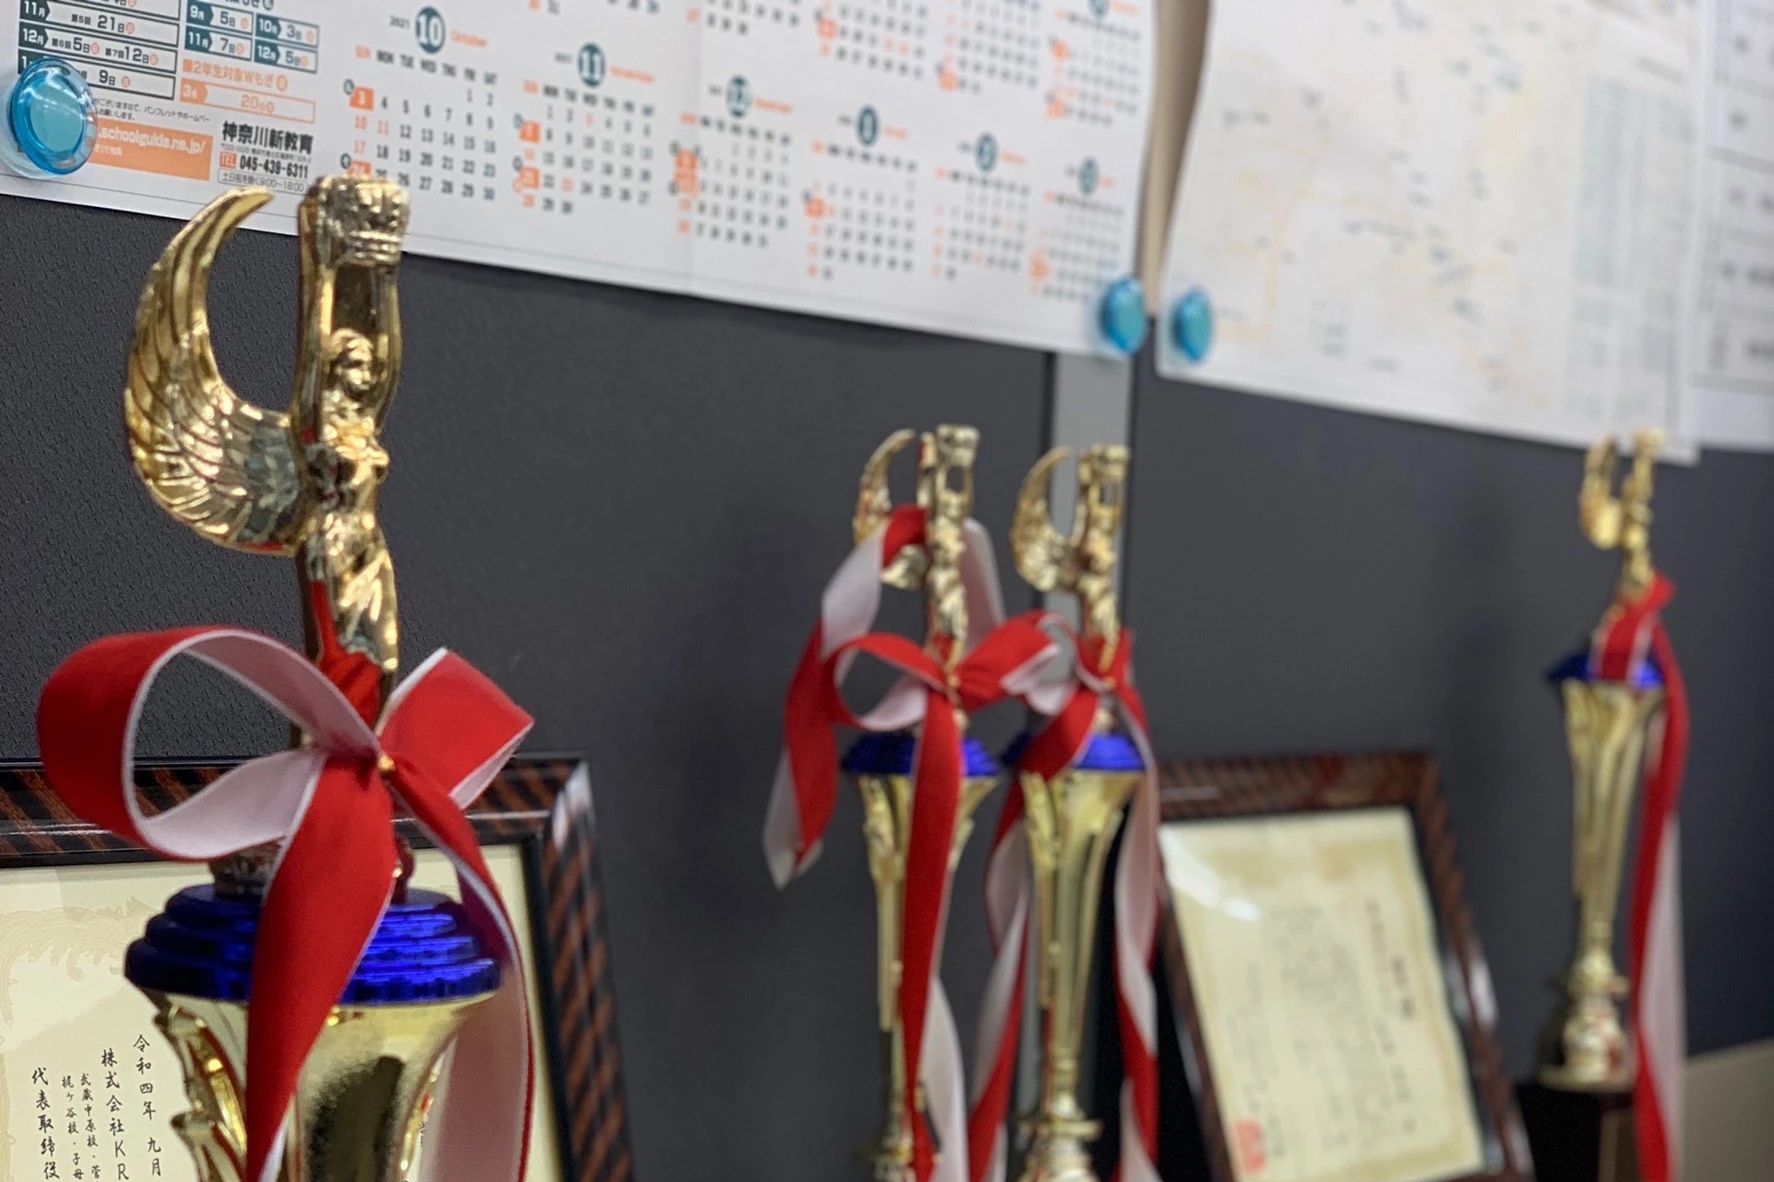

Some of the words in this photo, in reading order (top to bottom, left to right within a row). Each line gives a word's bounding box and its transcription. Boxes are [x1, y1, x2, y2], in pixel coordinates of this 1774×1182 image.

[24, 1, 46, 18] 11月
[97, 15, 125, 33] 21日
[190, 5, 205, 20] 9月
[220, 11, 236, 27] 5日
[259, 18, 278, 35] 10月
[188, 31, 209, 48] 11月
[219, 37, 235, 53] 7日
[417, 13, 443, 48] 10
[22, 28, 45, 46] 12月
[73, 37, 90, 54] 5日
[124, 46, 149, 64] 12日
[376, 49, 394, 63] MON
[401, 54, 414, 69] TUE
[421, 59, 437, 73] WED
[99, 70, 116, 85] 9日
[222, 120, 314, 155] 神奈川新教育
[239, 155, 309, 179] 045-439-6311
[133, 1034, 156, 1120] 令和四年
